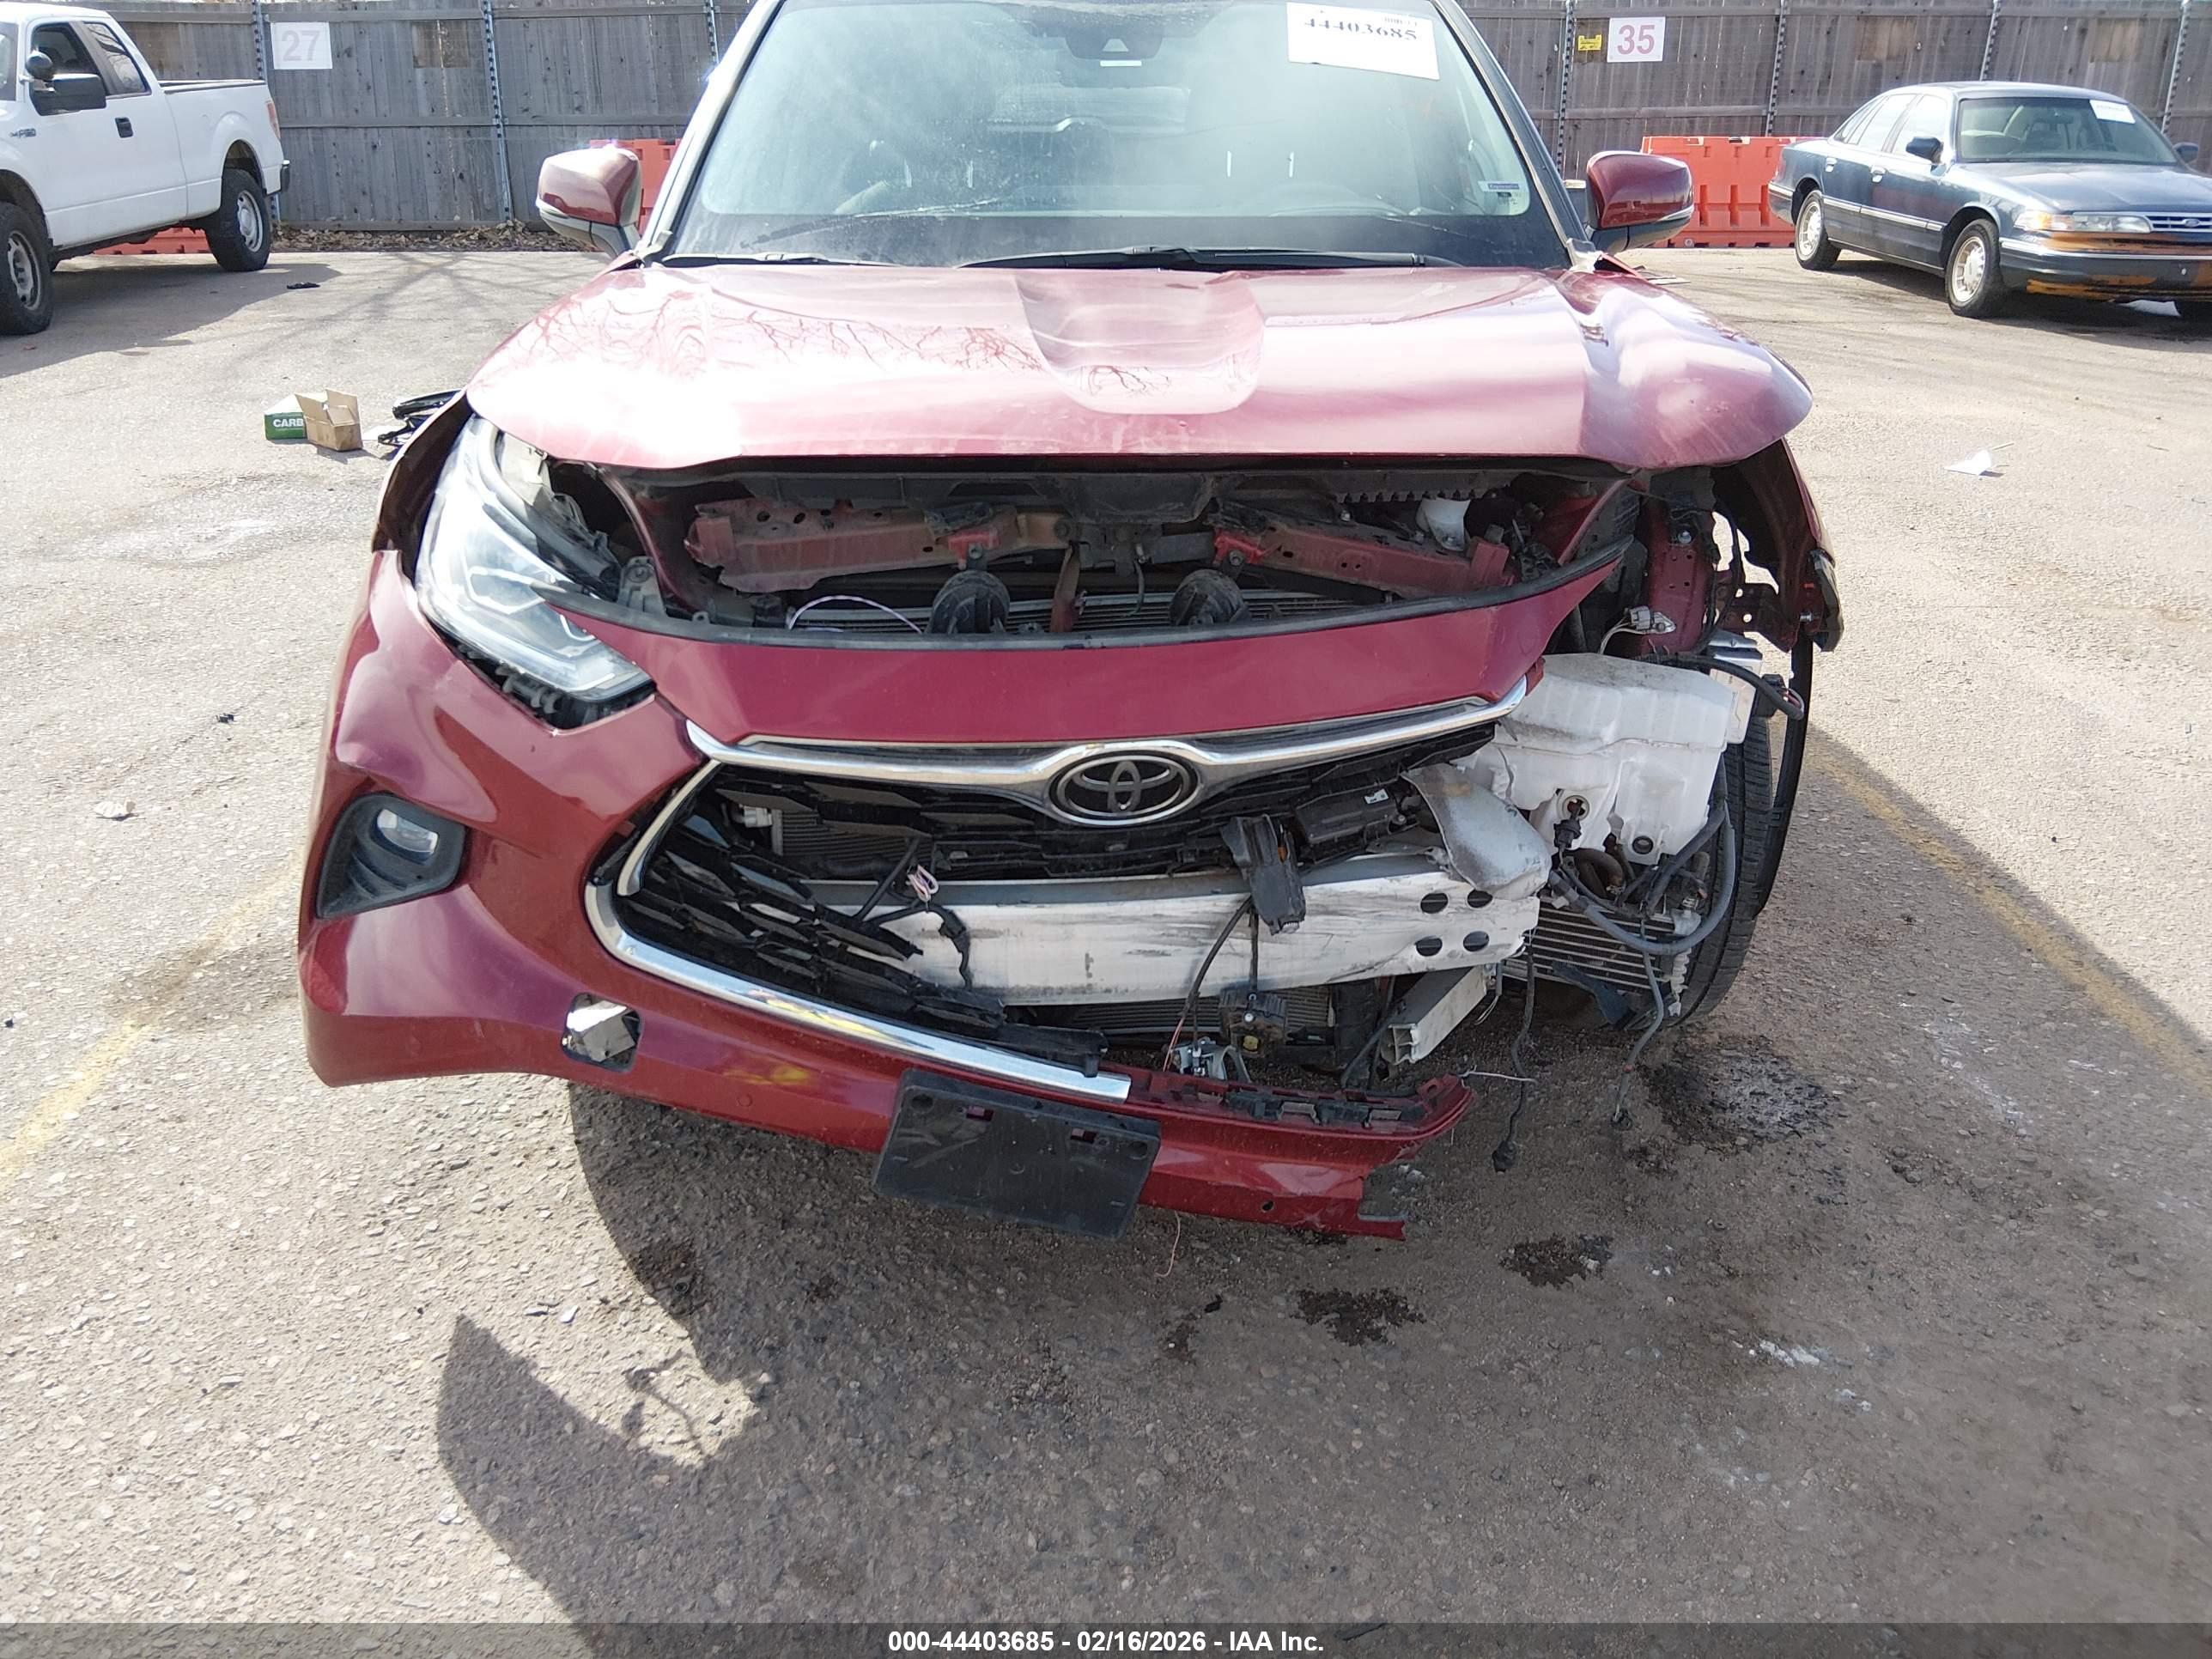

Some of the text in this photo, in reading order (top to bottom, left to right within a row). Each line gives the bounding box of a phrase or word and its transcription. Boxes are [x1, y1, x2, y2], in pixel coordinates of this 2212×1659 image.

[1304, 17, 1418, 41] 44403685
[1617, 24, 1656, 55] 35
[281, 29, 321, 62] 27
[272, 417, 305, 428] CARB
